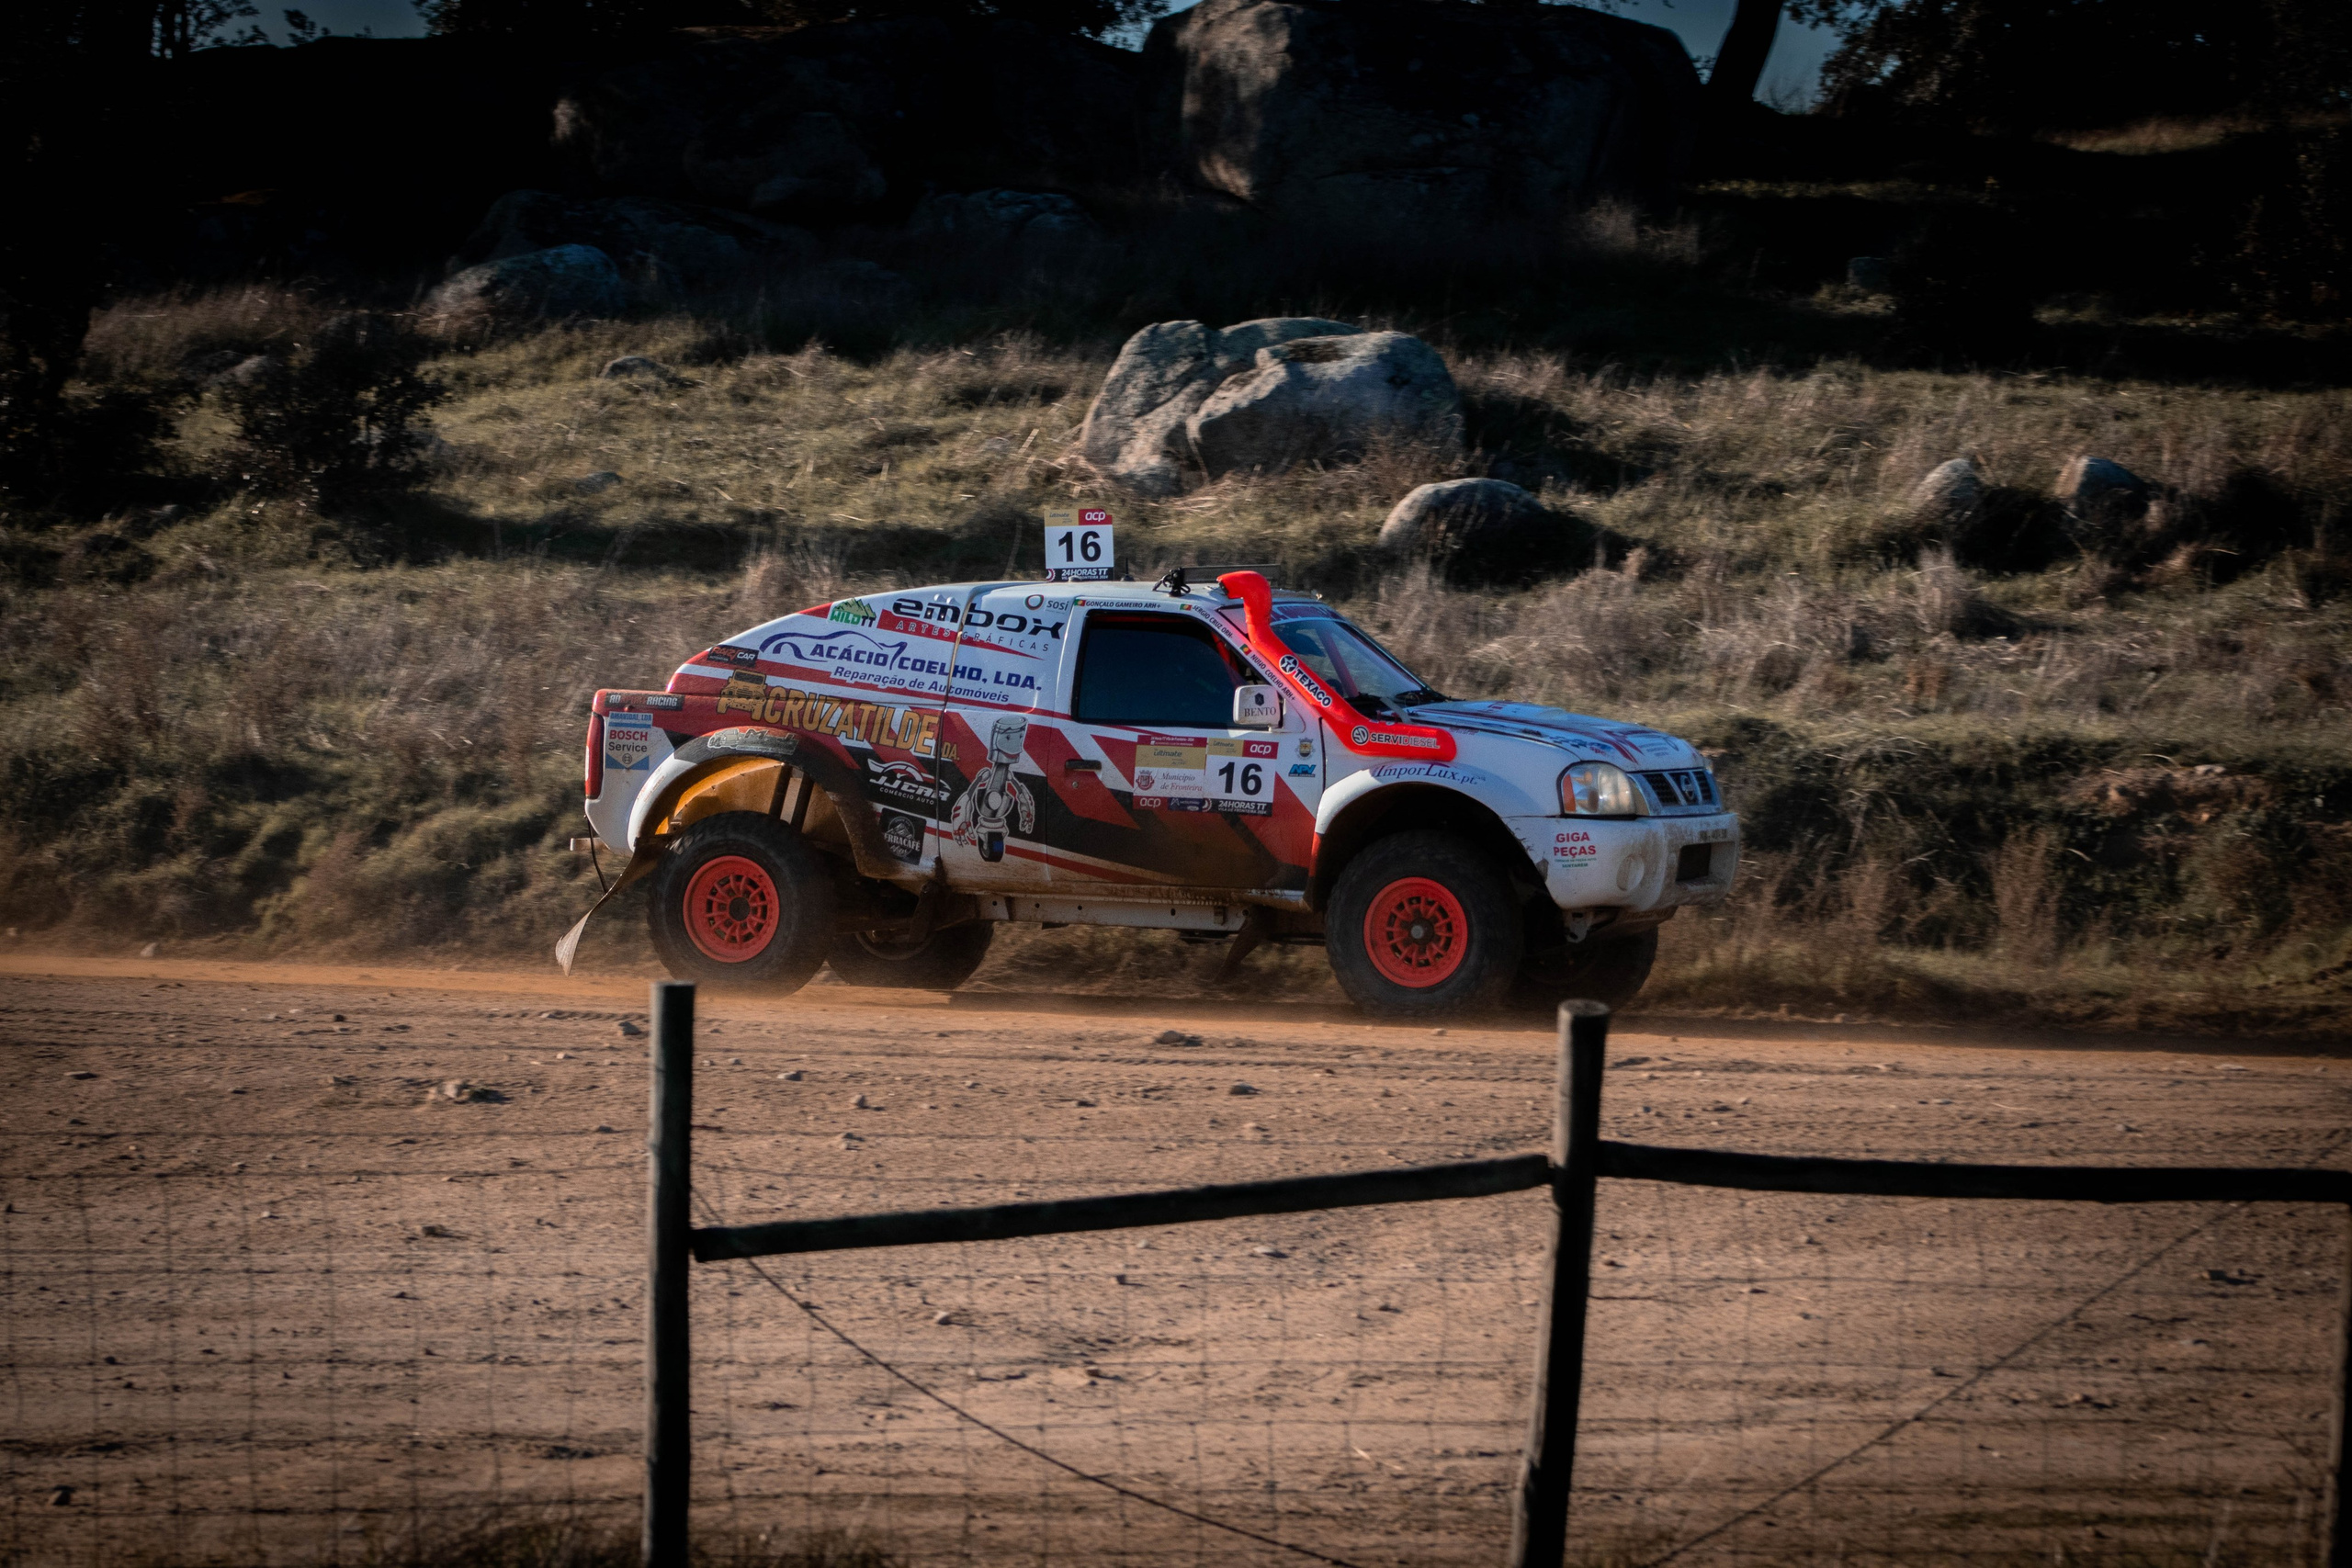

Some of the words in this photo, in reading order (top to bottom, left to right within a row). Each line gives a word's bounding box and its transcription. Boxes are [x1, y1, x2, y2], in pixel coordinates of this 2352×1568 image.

[1085, 512, 1106, 522] acp
[1057, 530, 1102, 563] 16
[1046, 599, 1069, 612] sosi
[1085, 600, 1114, 609] GONÇALO
[1114, 601, 1143, 609] GAMEIRO
[891, 597, 1066, 640] embox
[1192, 604, 1211, 620] SERGIO
[1209, 616, 1223, 630] CRUZ
[895, 620, 951, 637] ARTES
[961, 630, 1049, 653] GRÁFICAS
[809, 644, 889, 667] ACÁCIO
[993, 670, 1043, 692] LDA.
[1250, 654, 1267, 670] NUNO
[1264, 669, 1283, 688] COELHO
[833, 665, 906, 688] Reparação
[908, 676, 925, 690] de
[927, 680, 1010, 704] Automóveis
[1294, 668, 1332, 708] TEXACO
[646, 695, 679, 707] RACING
[1243, 705, 1277, 718] BENTO
[763, 686, 942, 754] CRUZATILDE
[609, 728, 649, 742] BOSCH
[1370, 732, 1441, 750] SERVIDIESEL
[607, 741, 648, 753] Service
[1250, 743, 1272, 755] acp
[1161, 772, 1196, 783] Município
[1217, 761, 1263, 796] 16
[1159, 782, 1170, 790] de
[1170, 783, 1204, 792] Fronteira
[879, 786, 915, 800] COMÉRCIO
[916, 796, 935, 806] AUTO
[1139, 797, 1161, 808] acp
[1256, 802, 1268, 811] TT
[1555, 831, 1590, 843] GIGA
[1553, 844, 1597, 859] PEÇAS
